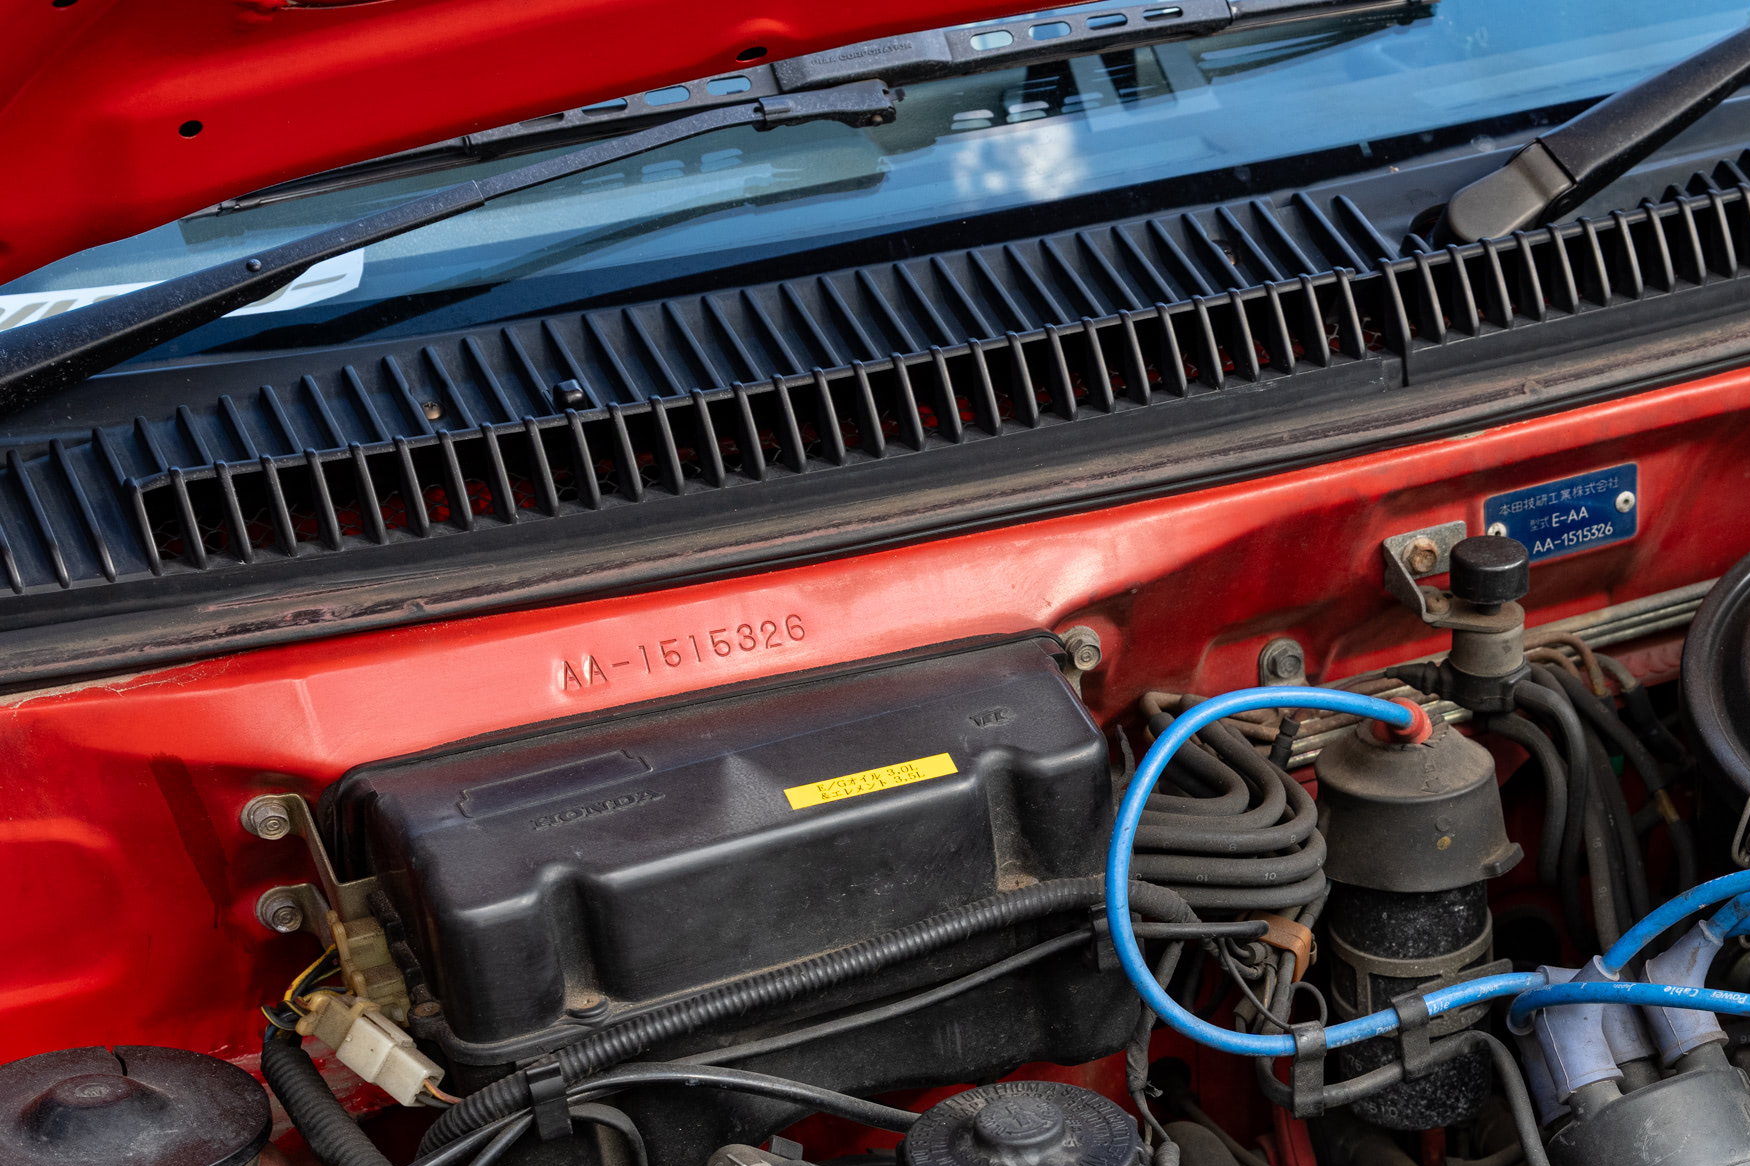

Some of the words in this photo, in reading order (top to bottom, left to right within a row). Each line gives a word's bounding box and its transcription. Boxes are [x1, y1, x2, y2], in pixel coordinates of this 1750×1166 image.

[1499, 476, 1618, 515] 本田技研工業株式会社
[1530, 516, 1550, 532] 型式
[1551, 506, 1589, 527] E-AA
[1533, 521, 1613, 555] AA-1515326
[561, 613, 806, 691] AA-1515326
[886, 764, 918, 777] 3.0L
[893, 771, 925, 784] 3.5L
[530, 790, 666, 831] HONDA
[1663, 985, 1699, 998] Cable
[1710, 990, 1748, 1005] Power
[1376, 1022, 1400, 1036] Pow
